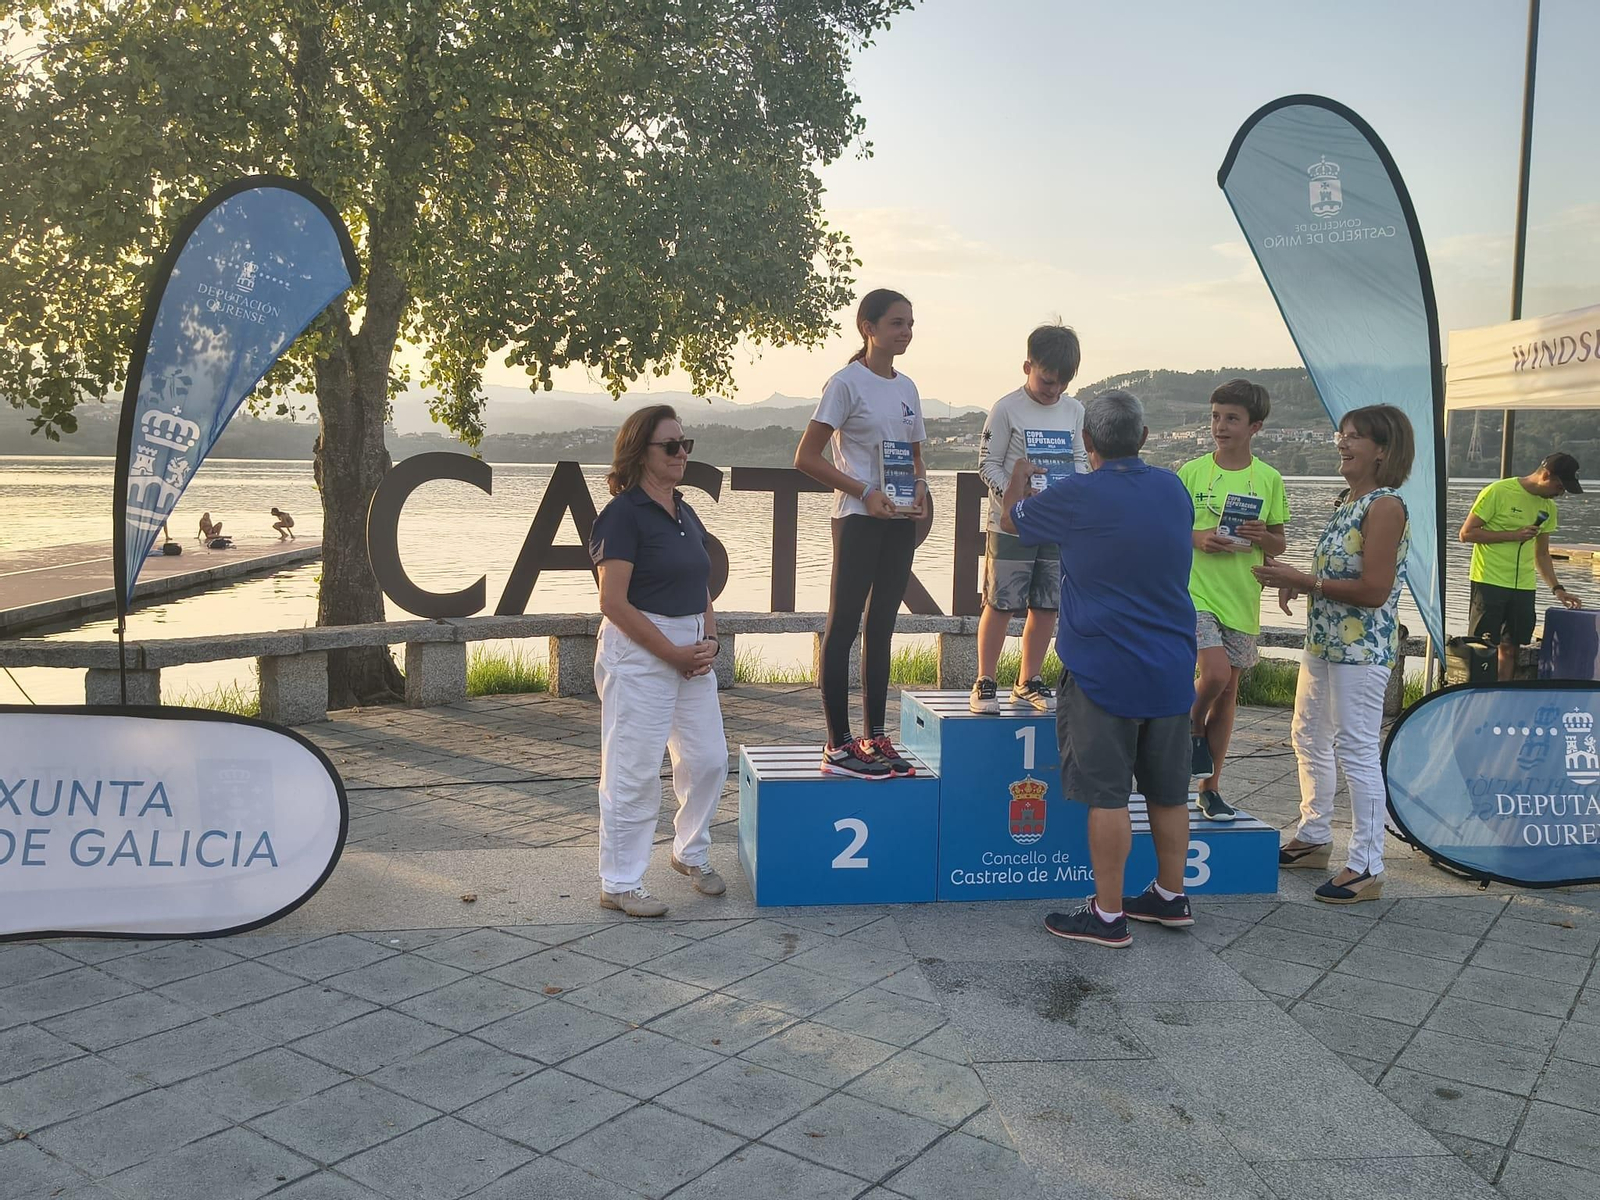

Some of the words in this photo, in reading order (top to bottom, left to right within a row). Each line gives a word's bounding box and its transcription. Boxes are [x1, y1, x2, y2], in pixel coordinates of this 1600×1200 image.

[197, 283, 281, 317] DEPUTACIÓN
[206, 299, 266, 325] OURENSE
[1512, 329, 1600, 373] WINDS
[1015, 725, 1036, 770] 1
[0, 779, 173, 817] XUNTA
[69, 828, 278, 867] GALICIA
[832, 818, 869, 868] 2
[1523, 823, 1600, 847] OURE
[951, 867, 1024, 885] Castrelo
[1027, 867, 1048, 883] de
[982, 851, 1047, 866] Concello
[1052, 850, 1070, 864] de
[1183, 840, 1210, 887] 3
